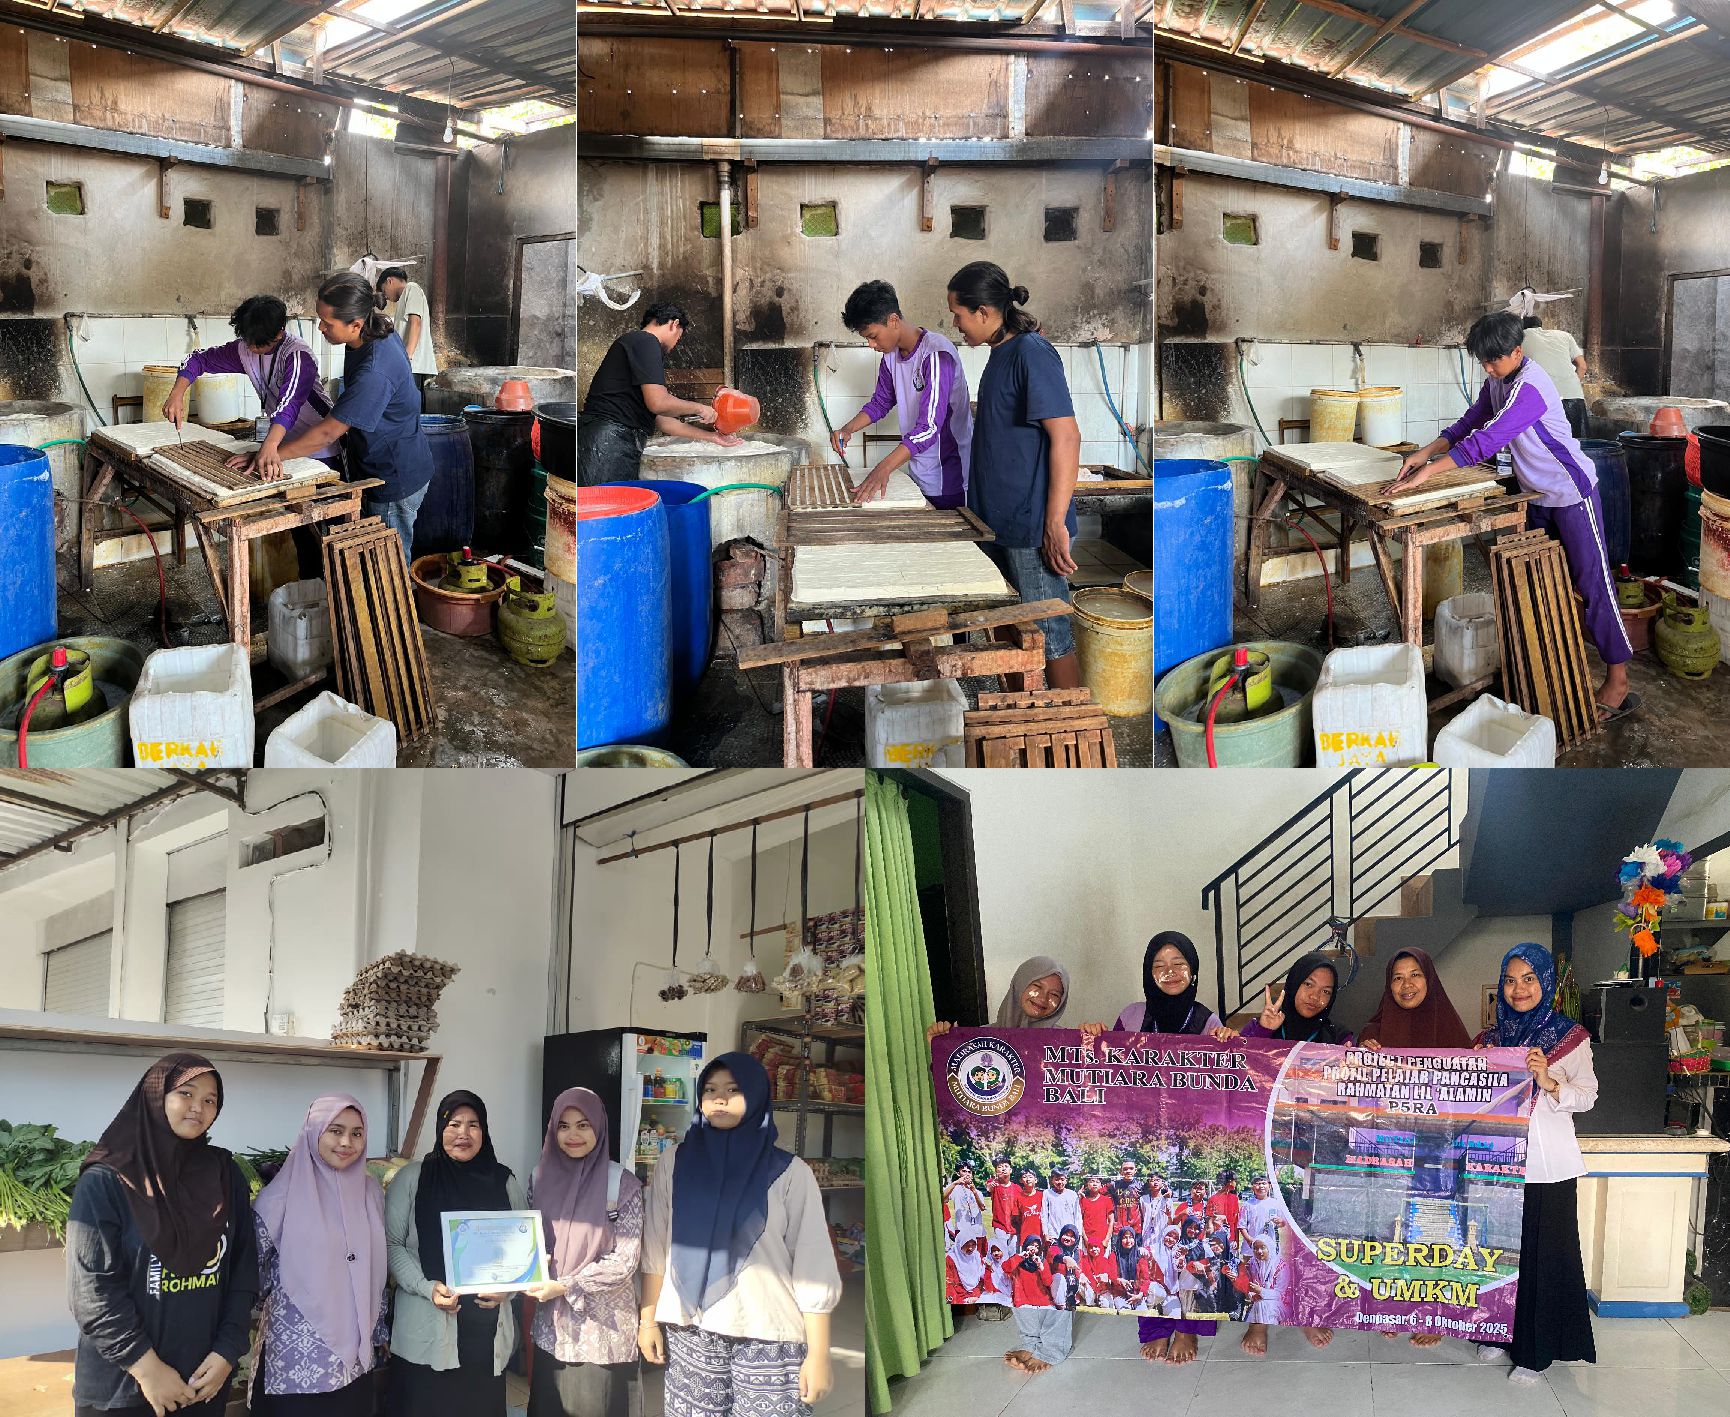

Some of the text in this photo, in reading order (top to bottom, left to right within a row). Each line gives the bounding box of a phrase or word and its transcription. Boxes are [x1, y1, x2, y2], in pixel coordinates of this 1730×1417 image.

[989, 1041, 1021, 1074] KARAKTER
[1043, 1046, 1247, 1070] MTs. KARAKTER
[1345, 1051, 1488, 1071] PROJECT PENGUATAN
[1043, 1068, 1258, 1092] MUTIARA BUNDA
[1323, 1066, 1509, 1087] PROFIL PELAJAR PANCASILA
[952, 1081, 980, 1111] MUTIARA
[1043, 1087, 1106, 1104] BALI
[1337, 1082, 1411, 1099] RAHMATAN
[1413, 1085, 1432, 1100] LIL
[1387, 1100, 1438, 1115] P5RA
[1345, 1154, 1414, 1168] MADRASAH
[1316, 1238, 1504, 1272] SUPERDAY
[162, 1272, 220, 1292] ROHMA
[1334, 1275, 1480, 1308] & UMKM
[1409, 1315, 1417, 1325] 6
[1435, 1316, 1478, 1333] Oktober
[1480, 1323, 1508, 1334] 2025
